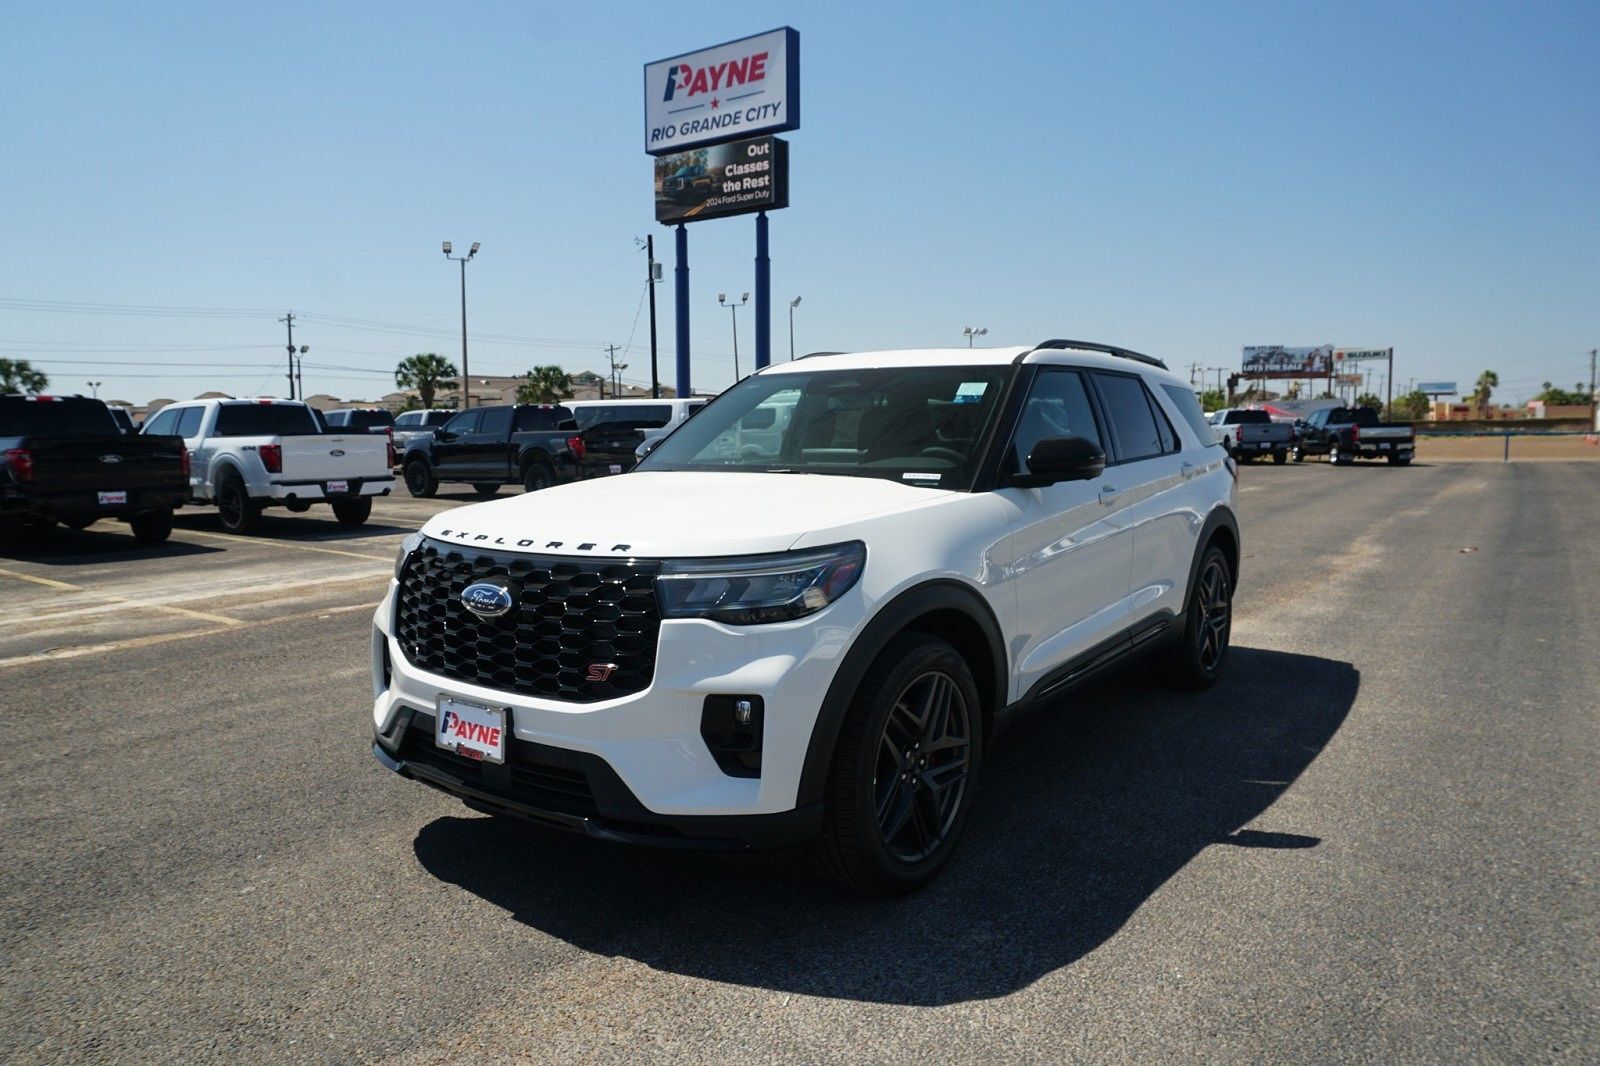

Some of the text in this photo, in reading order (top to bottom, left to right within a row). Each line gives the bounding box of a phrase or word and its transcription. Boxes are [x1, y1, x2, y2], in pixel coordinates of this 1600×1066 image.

[663, 51, 769, 102] PAYNE
[651, 101, 781, 142] RIO GRANDE CITY
[747, 142, 769, 157] Out
[725, 160, 769, 177] Classes
[722, 174, 769, 193] the Rest
[706, 190, 769, 207] 2024 Ford Super Duty
[1347, 350, 1386, 359] SUZUKI
[440, 529, 632, 552] EXPLORER
[586, 663, 618, 681] ST
[441, 710, 501, 747] PAYNE
